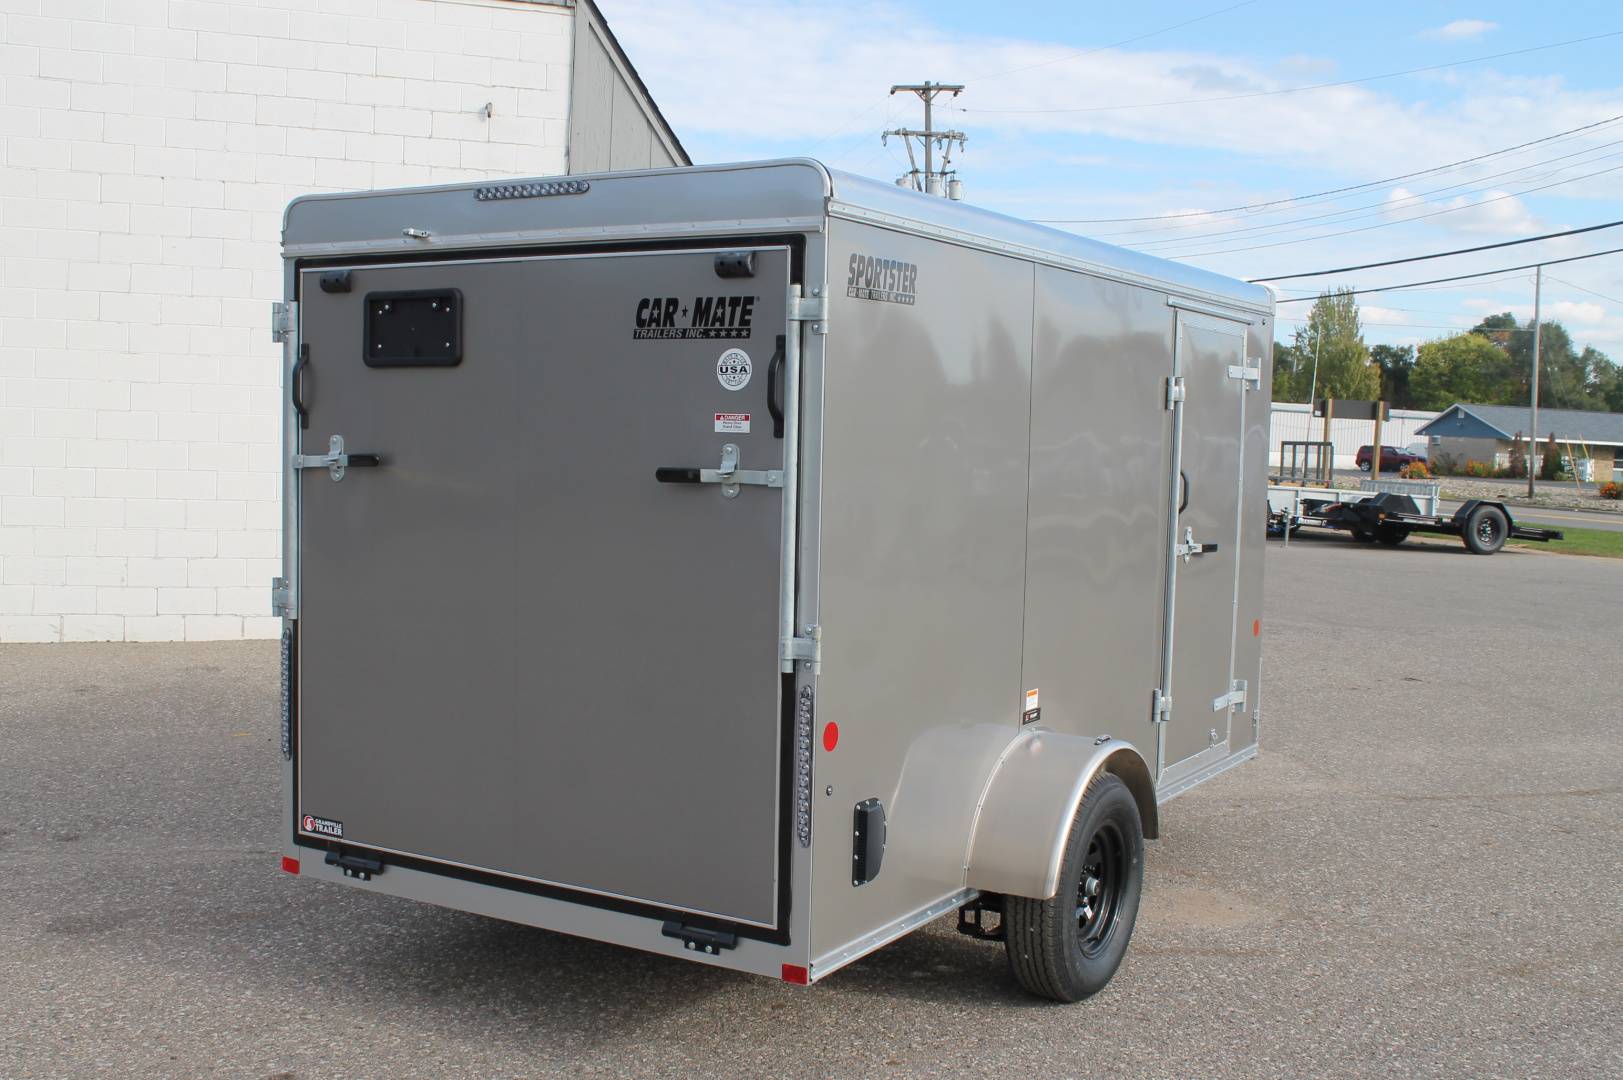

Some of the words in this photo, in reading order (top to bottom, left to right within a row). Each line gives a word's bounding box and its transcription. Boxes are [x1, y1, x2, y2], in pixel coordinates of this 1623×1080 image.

[848, 253, 917, 294] SPORTSTER
[636, 297, 679, 328] CAR
[691, 296, 755, 327] MATE
[635, 329, 683, 338] TRAILERS
[685, 328, 706, 338] INC.
[720, 366, 748, 374] USA
[315, 824, 343, 836] TRAILER
